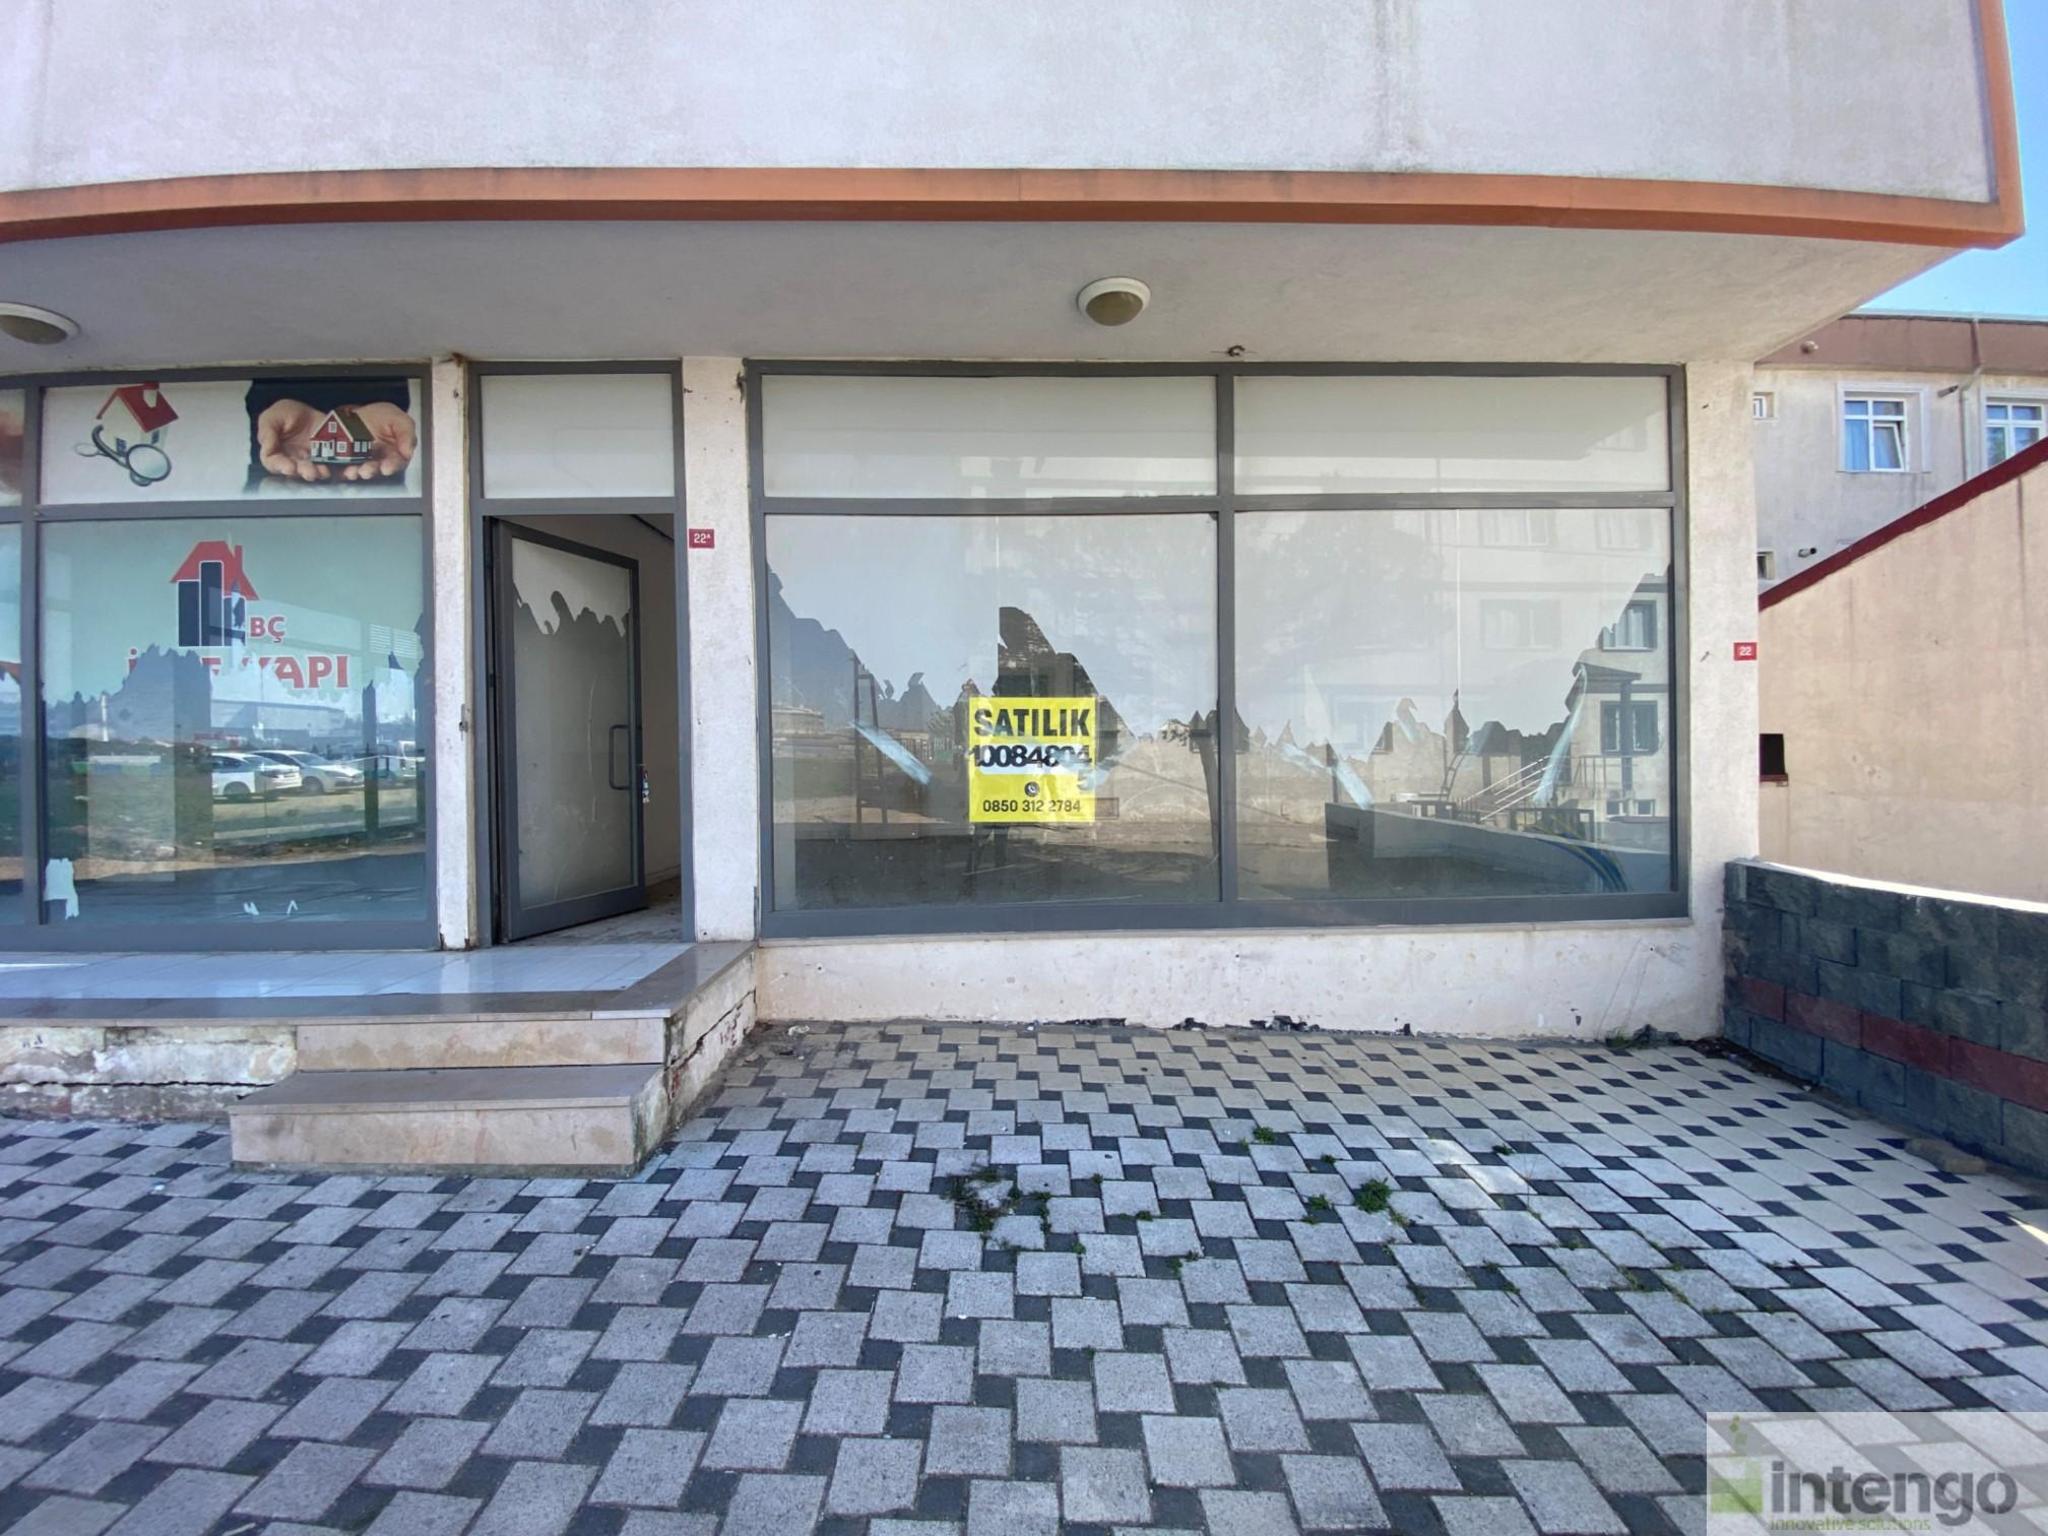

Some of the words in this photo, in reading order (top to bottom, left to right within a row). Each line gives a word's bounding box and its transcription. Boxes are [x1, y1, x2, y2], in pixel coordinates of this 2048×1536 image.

[249, 615, 285, 643] BÇ
[1739, 645, 1752, 656] 22
[974, 708, 1090, 737] SATILIK
[982, 799, 1018, 813] 0850
[1021, 799, 1045, 813] 312
[1048, 800, 1081, 813] 2784
